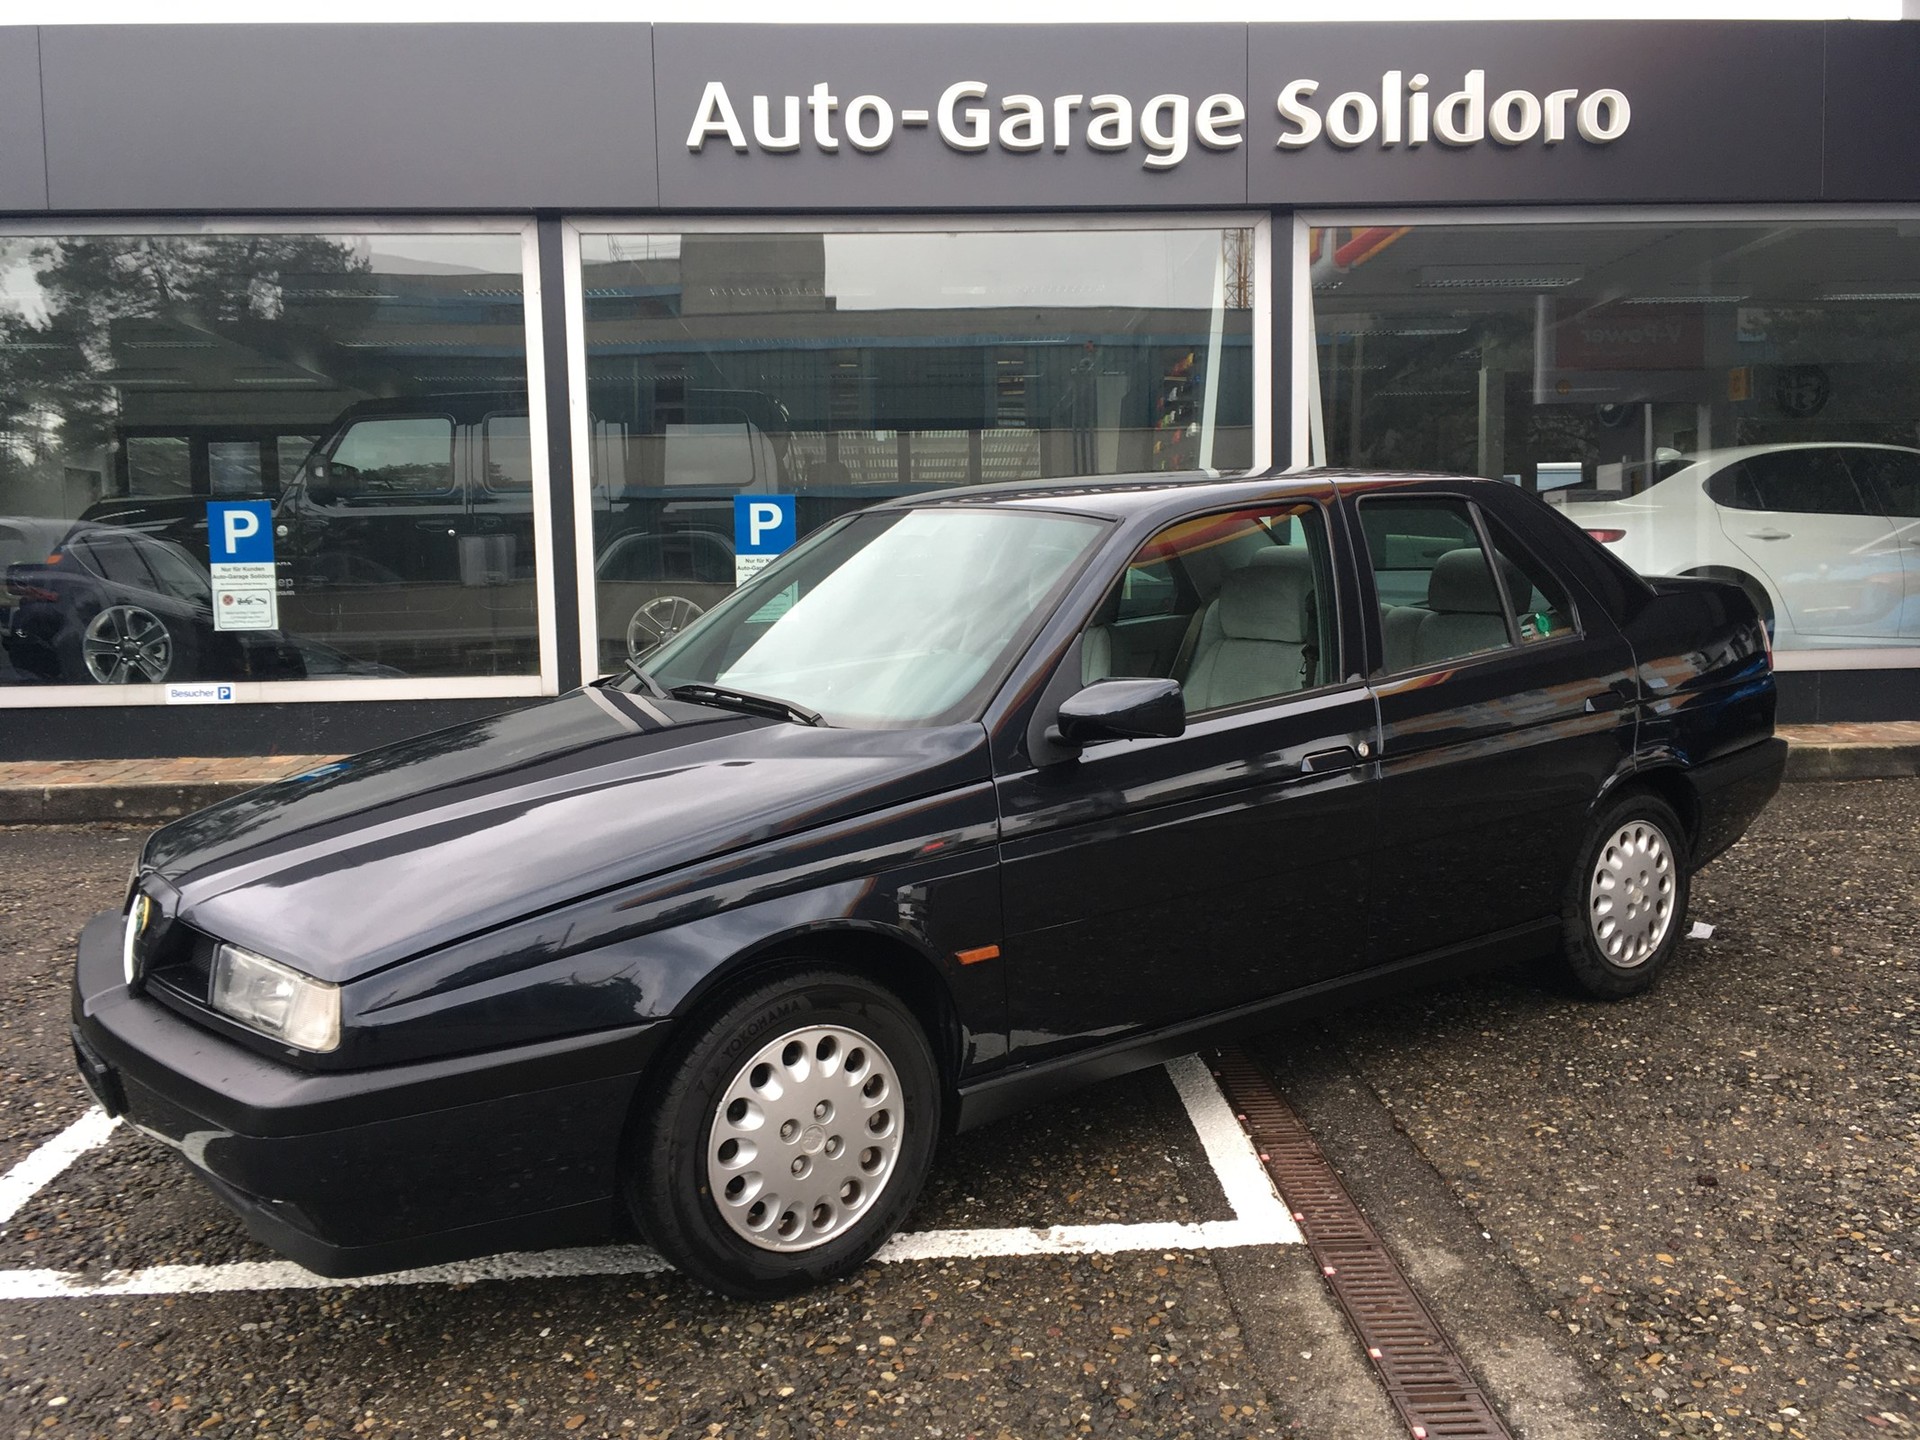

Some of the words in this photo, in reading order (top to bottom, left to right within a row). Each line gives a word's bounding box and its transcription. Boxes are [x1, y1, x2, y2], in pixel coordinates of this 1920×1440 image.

[686, 81, 1245, 170] Auto-Garage
[1276, 69, 1631, 149] Solidoro
[223, 510, 259, 554] P
[749, 503, 783, 546] P
[278, 578, 294, 588] ep
[171, 689, 214, 698] Besucher
[722, 1000, 801, 1058] YOKOHAMA
